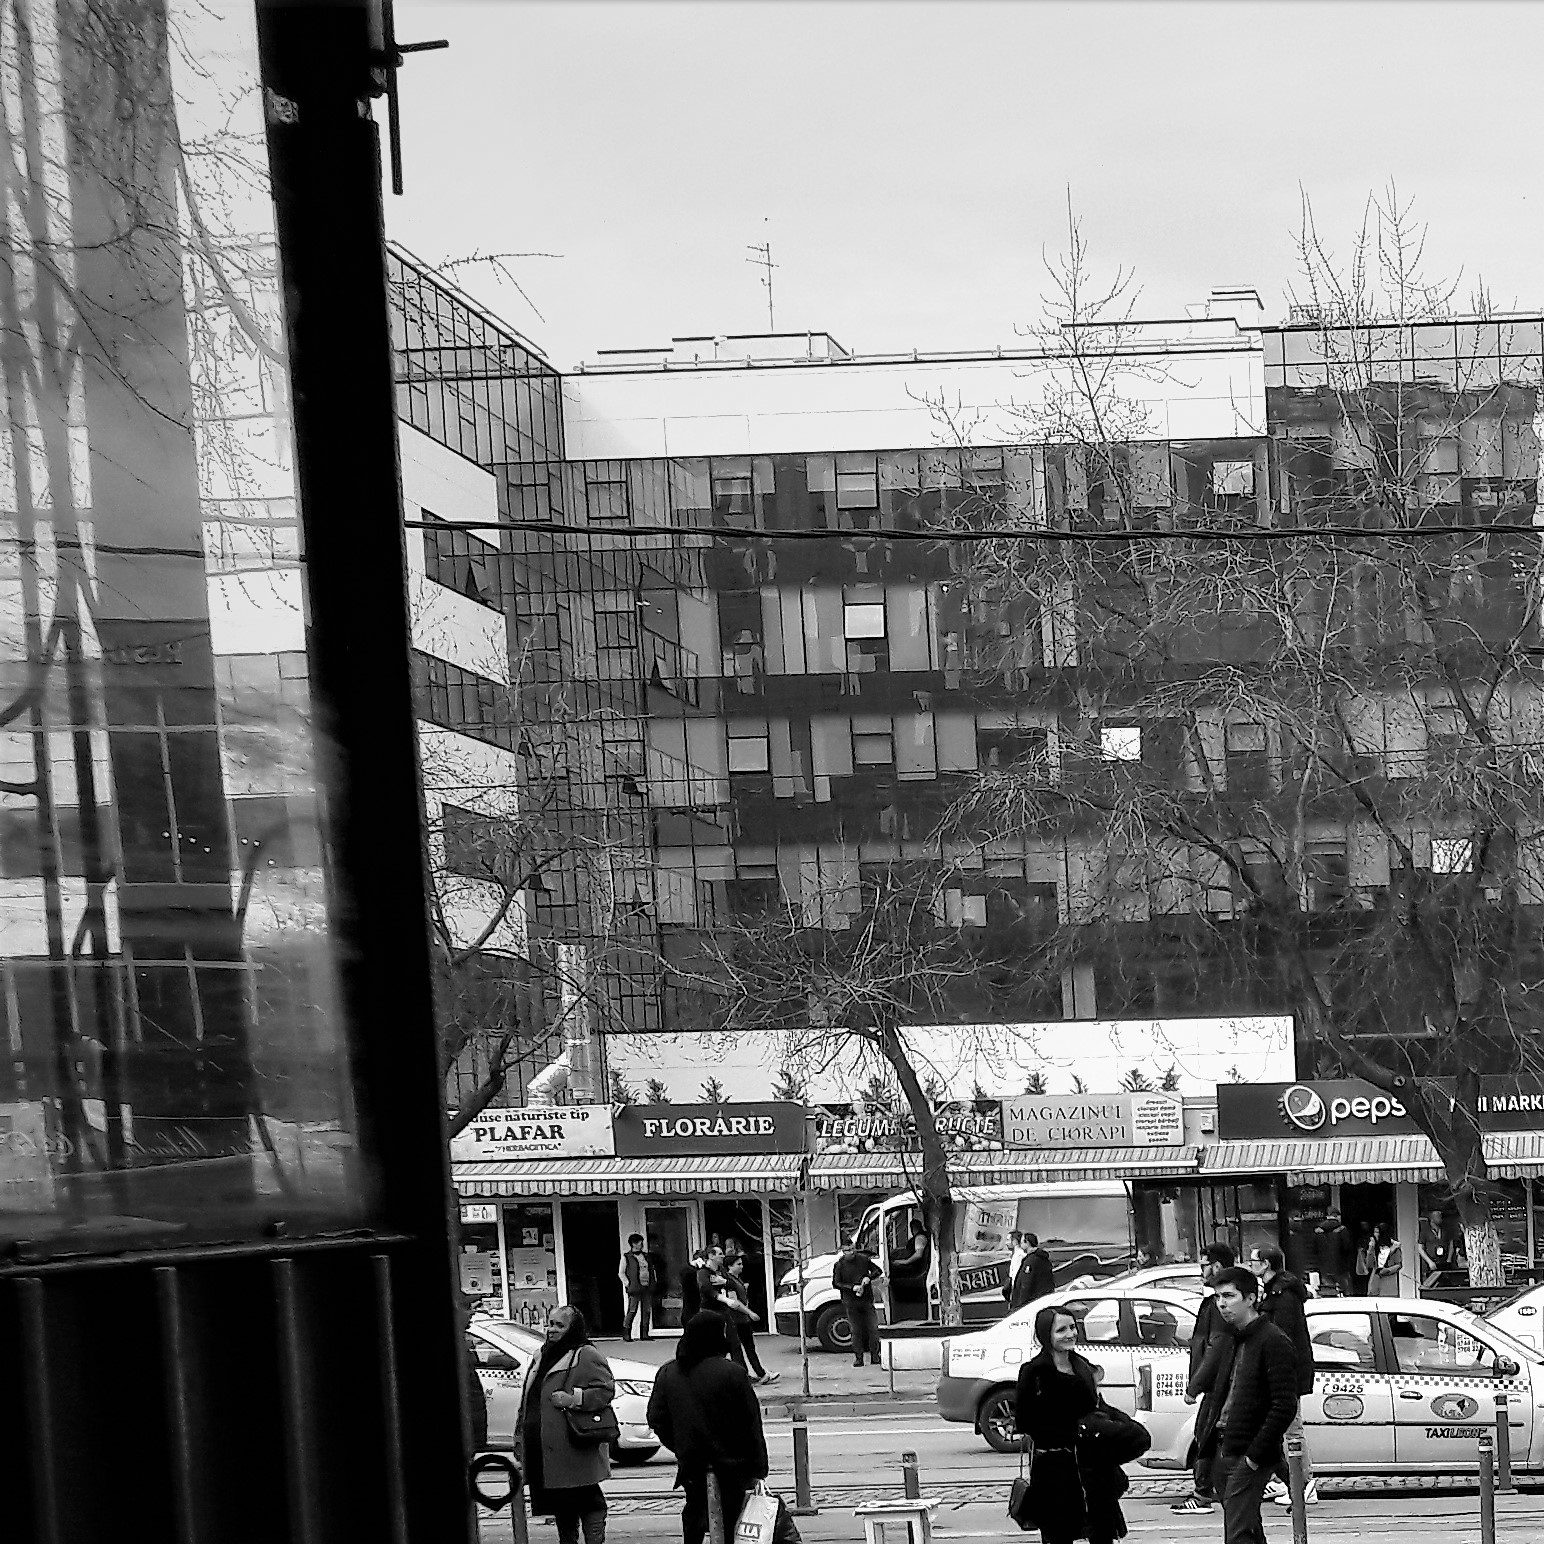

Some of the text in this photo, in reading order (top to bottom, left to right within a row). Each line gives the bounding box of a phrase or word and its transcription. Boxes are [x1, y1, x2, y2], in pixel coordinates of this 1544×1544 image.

[570, 1110, 589, 1121] tip
[1330, 1096, 1407, 1124] peps
[473, 1124, 565, 1142] PLAFAR
[934, 1116, 996, 1134] RUCTE
[1012, 1126, 1125, 1143] DE CIORAPI
[1332, 1383, 1364, 1394] 9425
